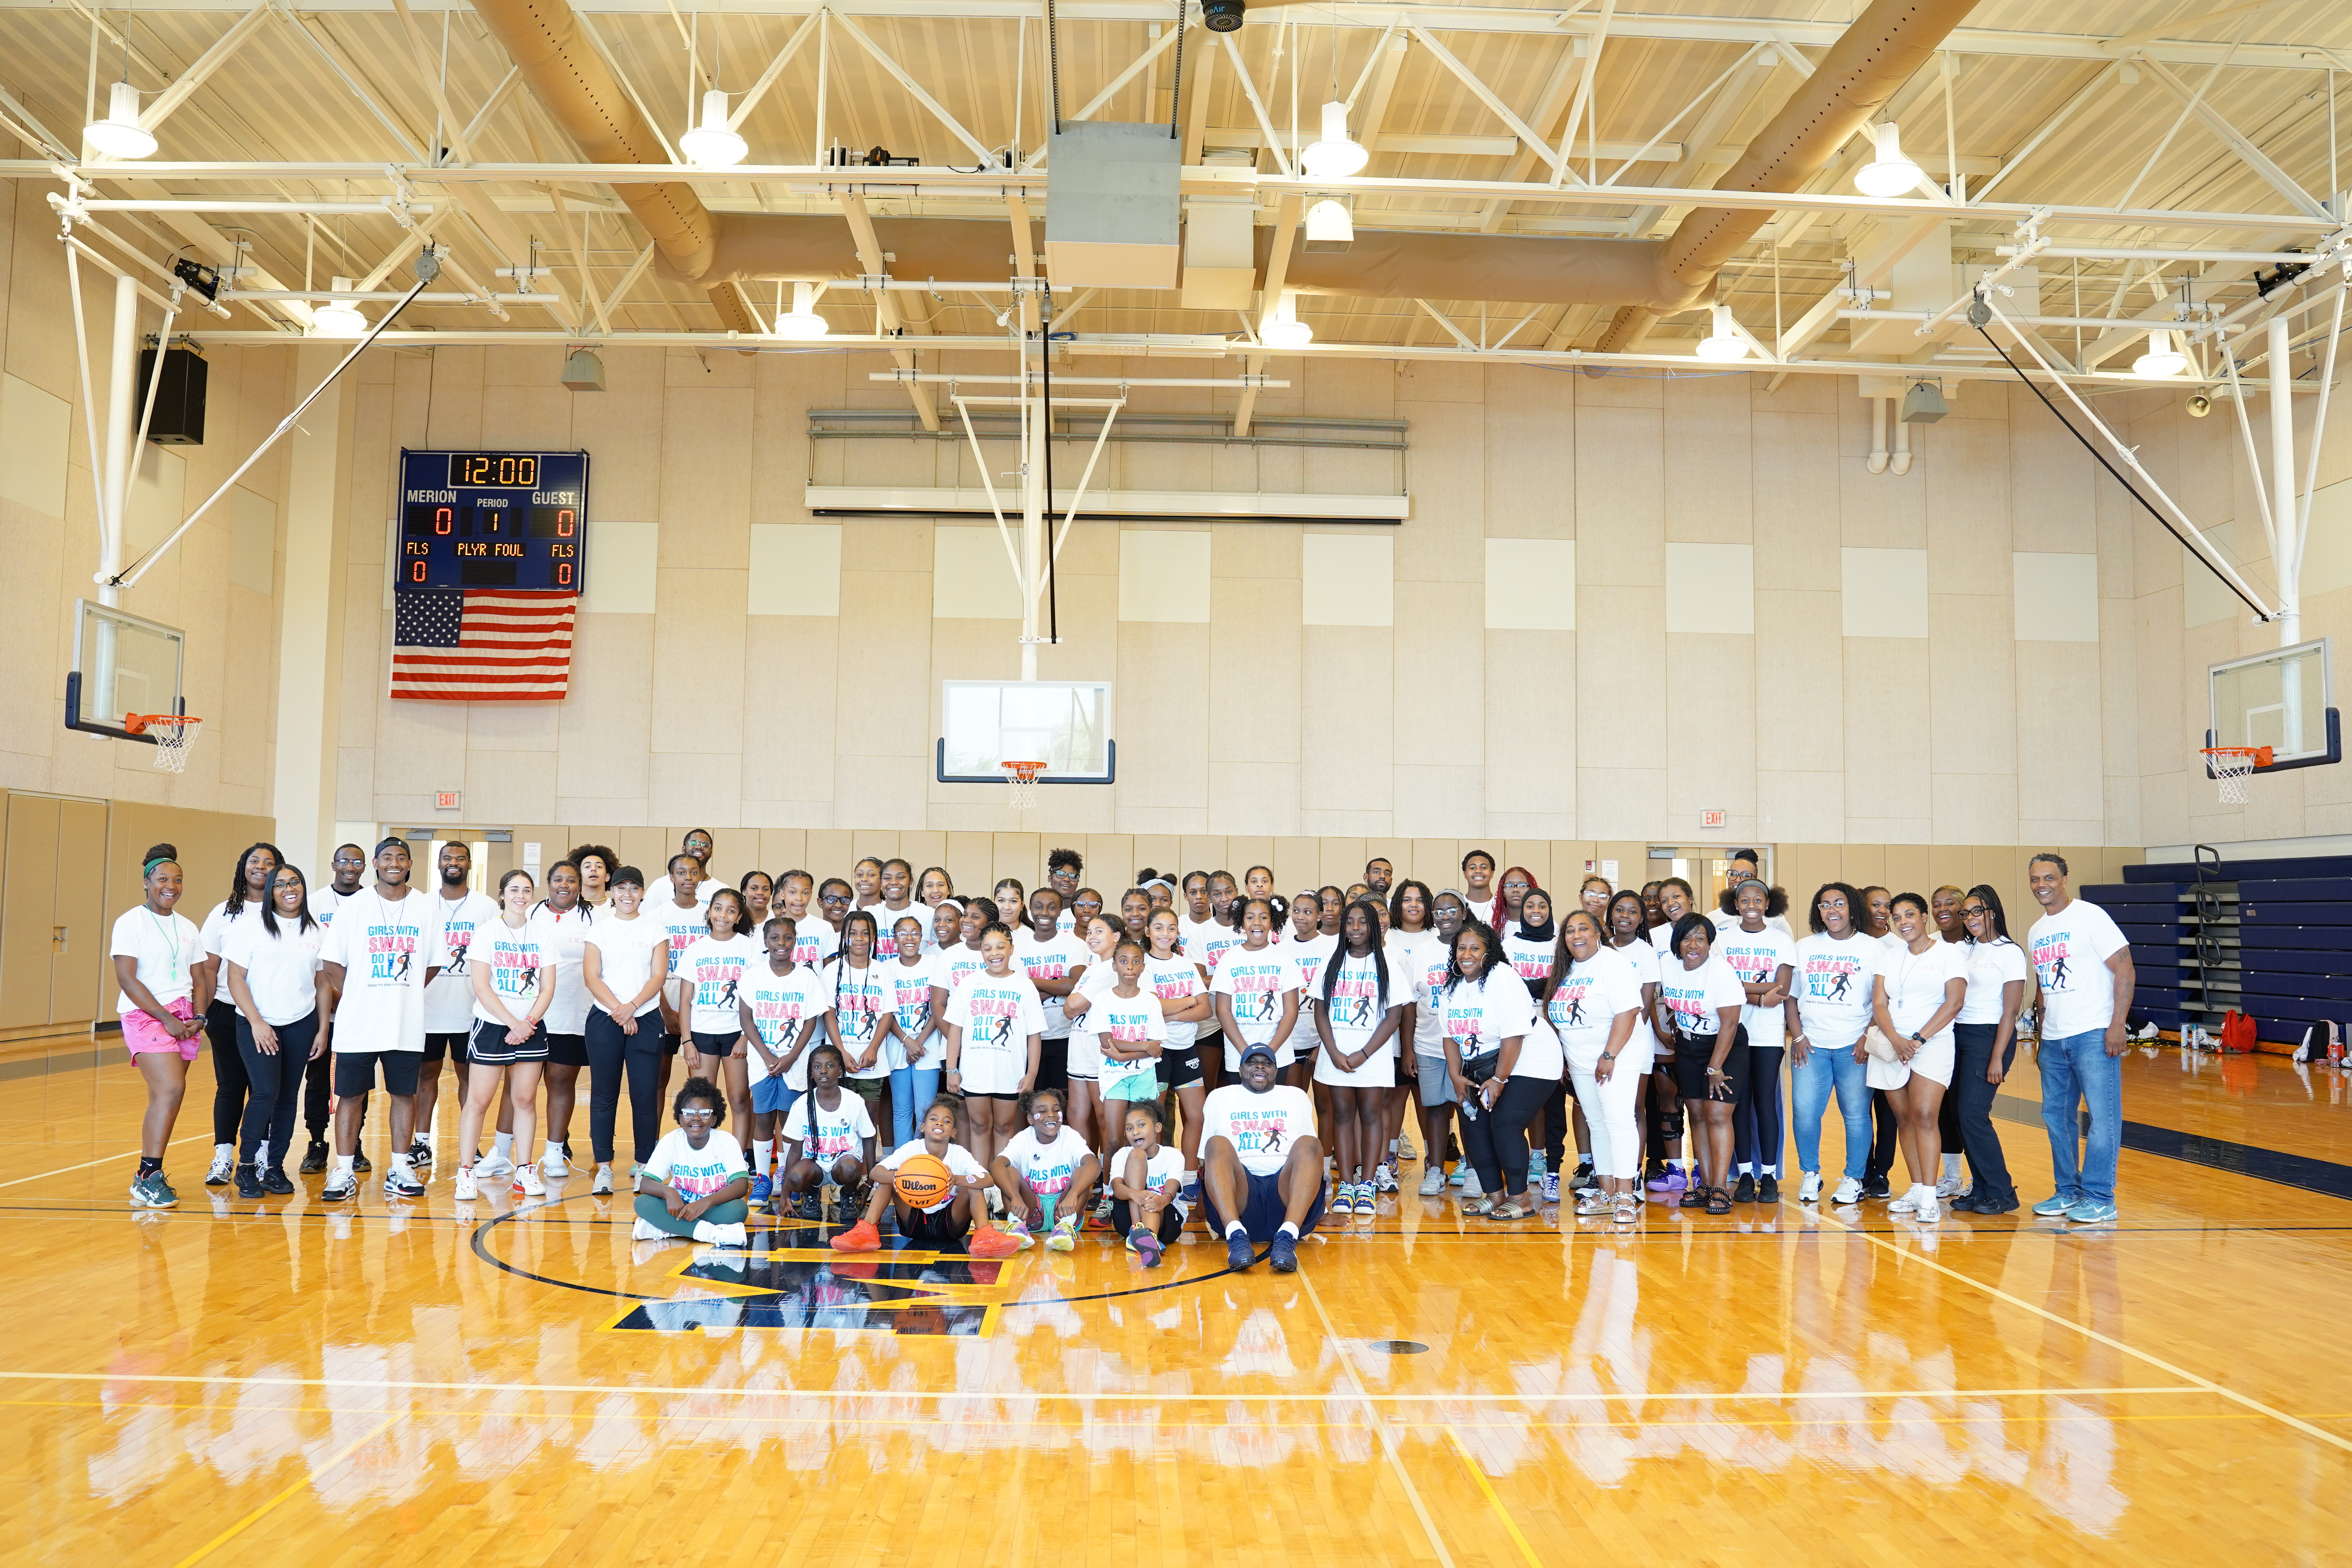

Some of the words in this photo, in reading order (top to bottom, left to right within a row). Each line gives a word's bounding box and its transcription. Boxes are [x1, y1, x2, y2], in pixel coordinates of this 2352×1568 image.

[465, 457, 534, 484] 12:00
[407, 490, 456, 503] MERION
[532, 492, 575, 505] GUEST
[477, 499, 508, 507] PERIOD
[436, 508, 452, 534] 0
[494, 513, 497, 531] 1
[558, 510, 573, 537] 0
[407, 543, 428, 555] FLS
[458, 543, 486, 556] PLYR
[495, 544, 523, 556] FOUL
[552, 545, 574, 557] FLS
[414, 561, 426, 582] 0
[559, 564, 571, 584] 0
[439, 793, 456, 806] EXIT
[1706, 812, 1722, 824] EXIT
[368, 926, 394, 936] GIRLS
[397, 926, 419, 936] WITH
[453, 922, 474, 930] WITH
[1207, 940, 1230, 951] GIRLS
[2034, 936, 2050, 949] GIRLS
[2052, 932, 2070, 943] WITH
[1754, 948, 1776, 957] WITH
[372, 954, 384, 963] DO
[696, 957, 720, 966] GIRLS
[723, 957, 745, 965] WITH
[1044, 954, 1066, 963] WITH
[1538, 955, 1555, 963] WIT
[1837, 956, 1859, 964] WITH
[372, 965, 394, 978] ALL
[952, 962, 976, 970] GIRLS
[1231, 966, 1255, 977] GIRLS
[1258, 965, 1281, 975] WITH
[1806, 961, 1855, 975] S.W.A.G.
[497, 969, 511, 978] DO
[512, 969, 519, 978] IT
[1174, 970, 1194, 980] WITH
[1356, 972, 1378, 982] WITH
[1744, 971, 1751, 980] IT
[1808, 974, 1819, 983] DO
[1822, 974, 1830, 982] IT
[498, 979, 518, 992] ALL
[712, 982, 720, 991] IT
[914, 977, 929, 986] WIT
[1234, 976, 1280, 993] S.W.A.G.
[1575, 977, 1593, 985] WITH
[1665, 987, 1683, 998] GIRLS
[1686, 990, 1704, 999] WITH
[1809, 984, 1827, 996] ALL
[697, 992, 718, 1005] ALL
[756, 991, 779, 1002] GIRLS
[782, 992, 804, 1002] WITH
[1000, 990, 1021, 1003] WITH
[1236, 994, 1246, 1004] DO
[1249, 993, 1257, 1003] IT
[1344, 998, 1352, 1007] IT
[1549, 1002, 1557, 1011] DO
[1559, 1003, 1566, 1011] IT
[756, 1002, 802, 1019] S.W.A.G.
[906, 1005, 914, 1014] IT
[1236, 1005, 1256, 1018] ALL
[1448, 1009, 1468, 1018] GIRLS
[757, 1019, 767, 1029] DO
[770, 1020, 779, 1029] IT
[974, 1017, 983, 1026] DO
[986, 1016, 995, 1025] IT
[1550, 1013, 1570, 1024] ALL
[973, 1027, 991, 1041] ALL
[1230, 1112, 1258, 1120] GIRLS
[1261, 1111, 1287, 1119] WITH
[1238, 1138, 1261, 1152] ALL
[674, 1164, 699, 1177] GIRLS
[700, 1163, 726, 1176] WITH
[1051, 1163, 1071, 1177] WITH
[902, 1180, 936, 1191] Wilson
